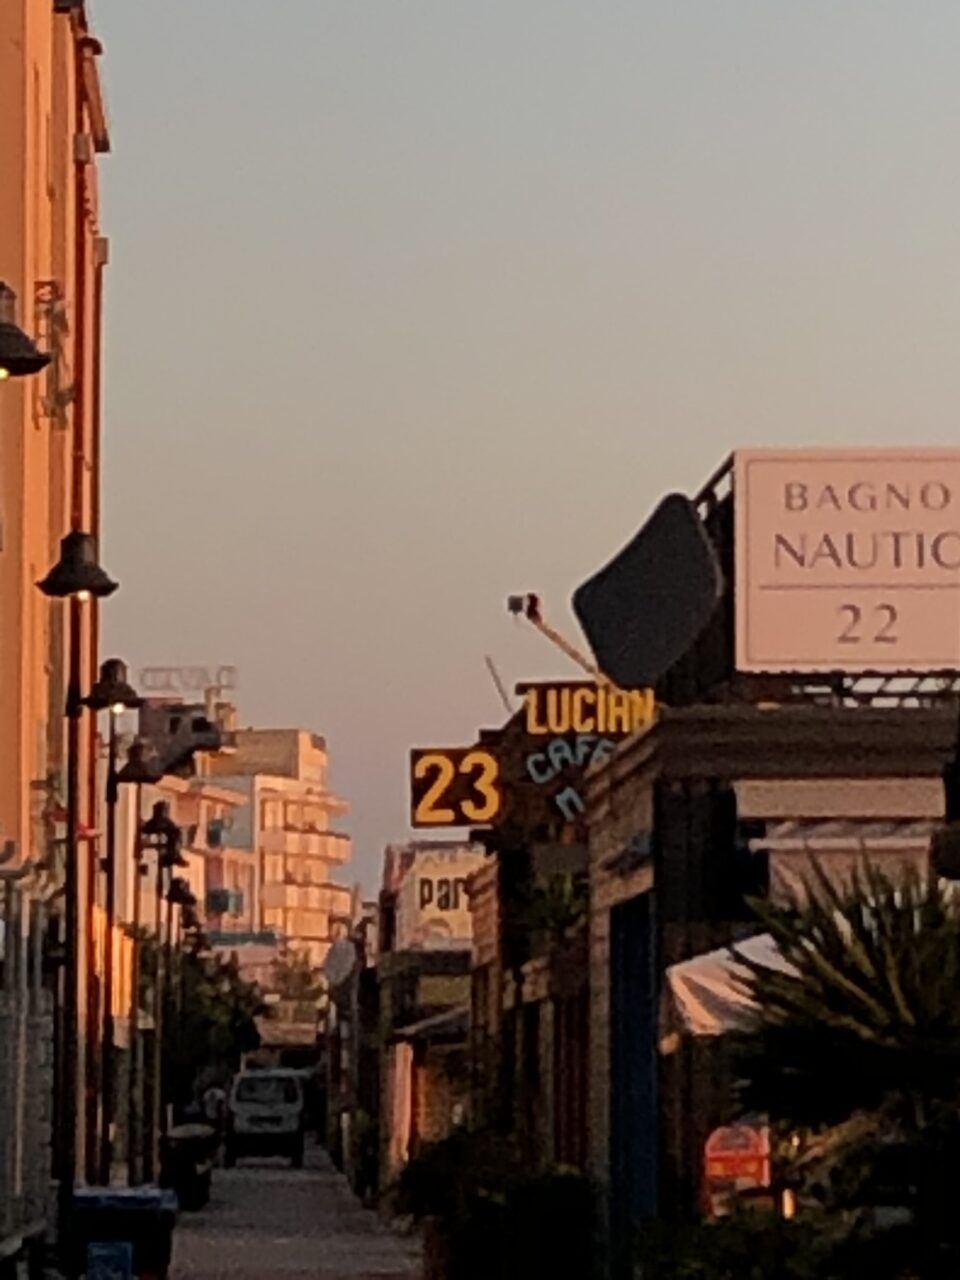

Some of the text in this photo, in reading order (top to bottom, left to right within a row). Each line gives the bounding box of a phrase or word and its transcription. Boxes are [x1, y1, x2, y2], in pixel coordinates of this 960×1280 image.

[784, 482, 950, 512] BAGNO
[837, 604, 898, 644] 22
[414, 751, 499, 823] 23
